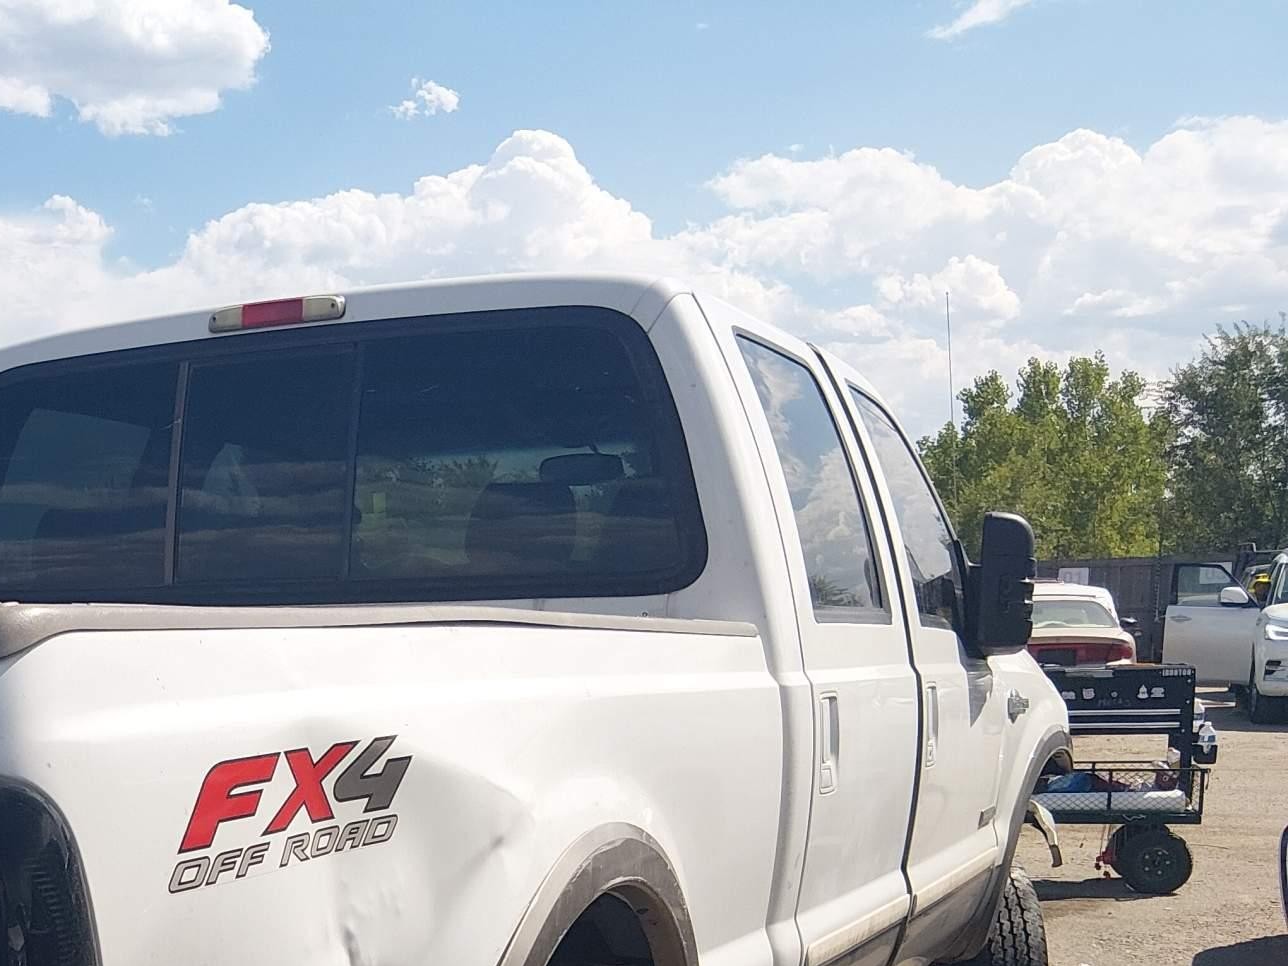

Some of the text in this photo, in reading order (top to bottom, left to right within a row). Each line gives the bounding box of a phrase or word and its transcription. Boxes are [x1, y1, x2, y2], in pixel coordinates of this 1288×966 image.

[177, 734, 414, 854] FX4
[168, 814, 398, 894] OFF ROAD
